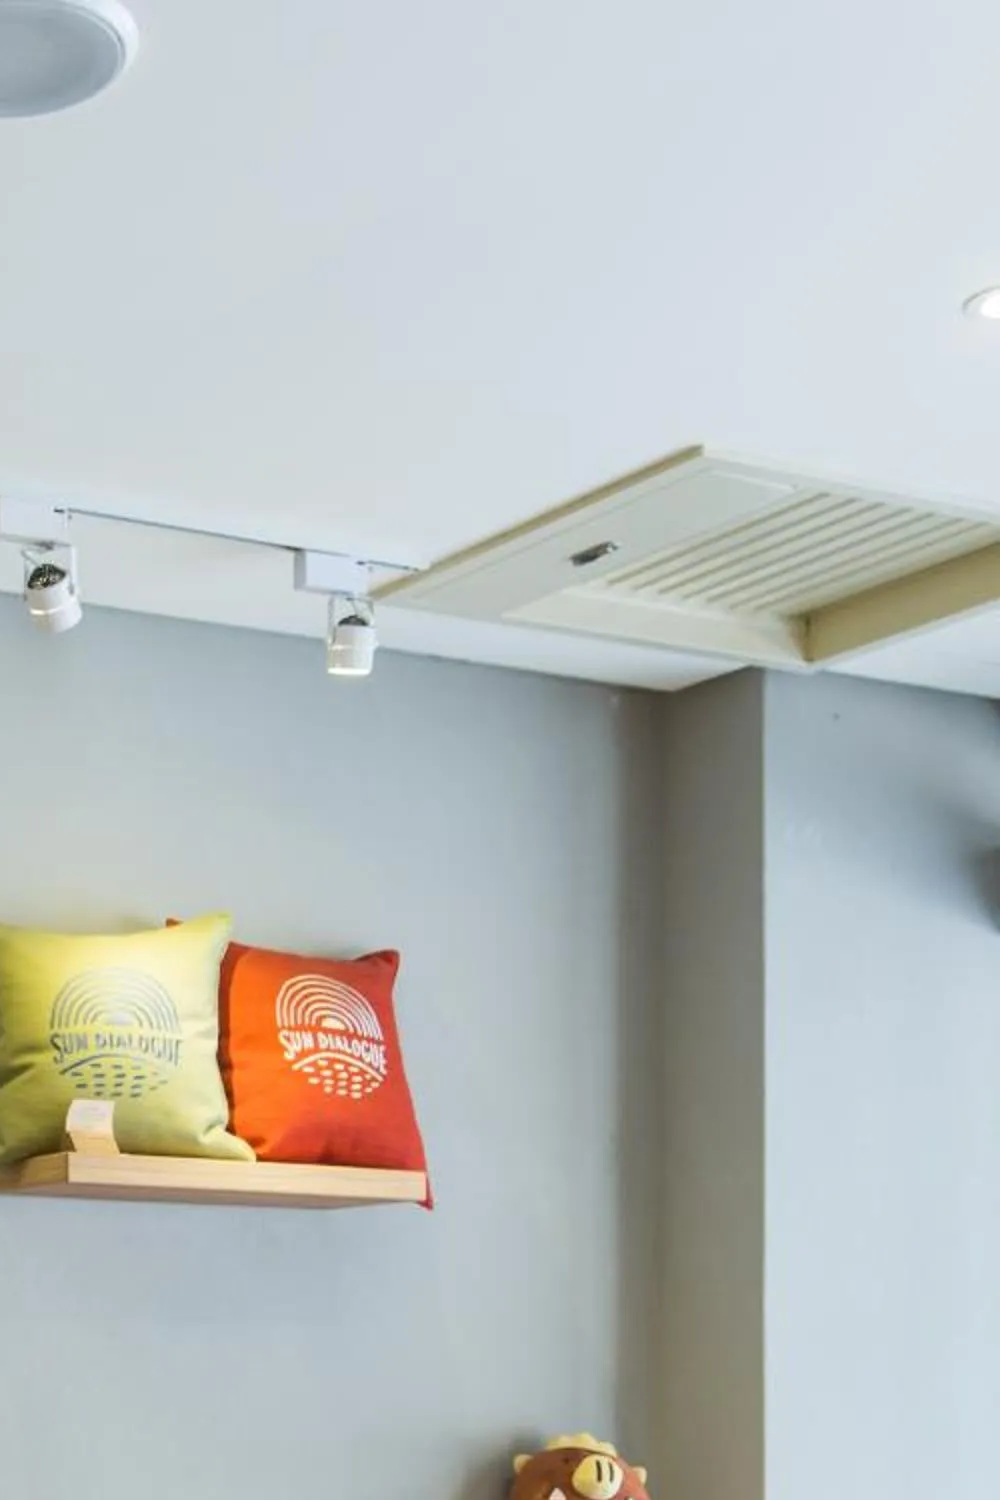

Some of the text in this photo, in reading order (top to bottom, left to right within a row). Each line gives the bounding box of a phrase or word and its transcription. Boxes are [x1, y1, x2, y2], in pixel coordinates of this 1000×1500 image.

[51, 1032, 183, 1067] SUN DIALOGUE
[278, 1029, 387, 1075] SUN DIALOGUE
